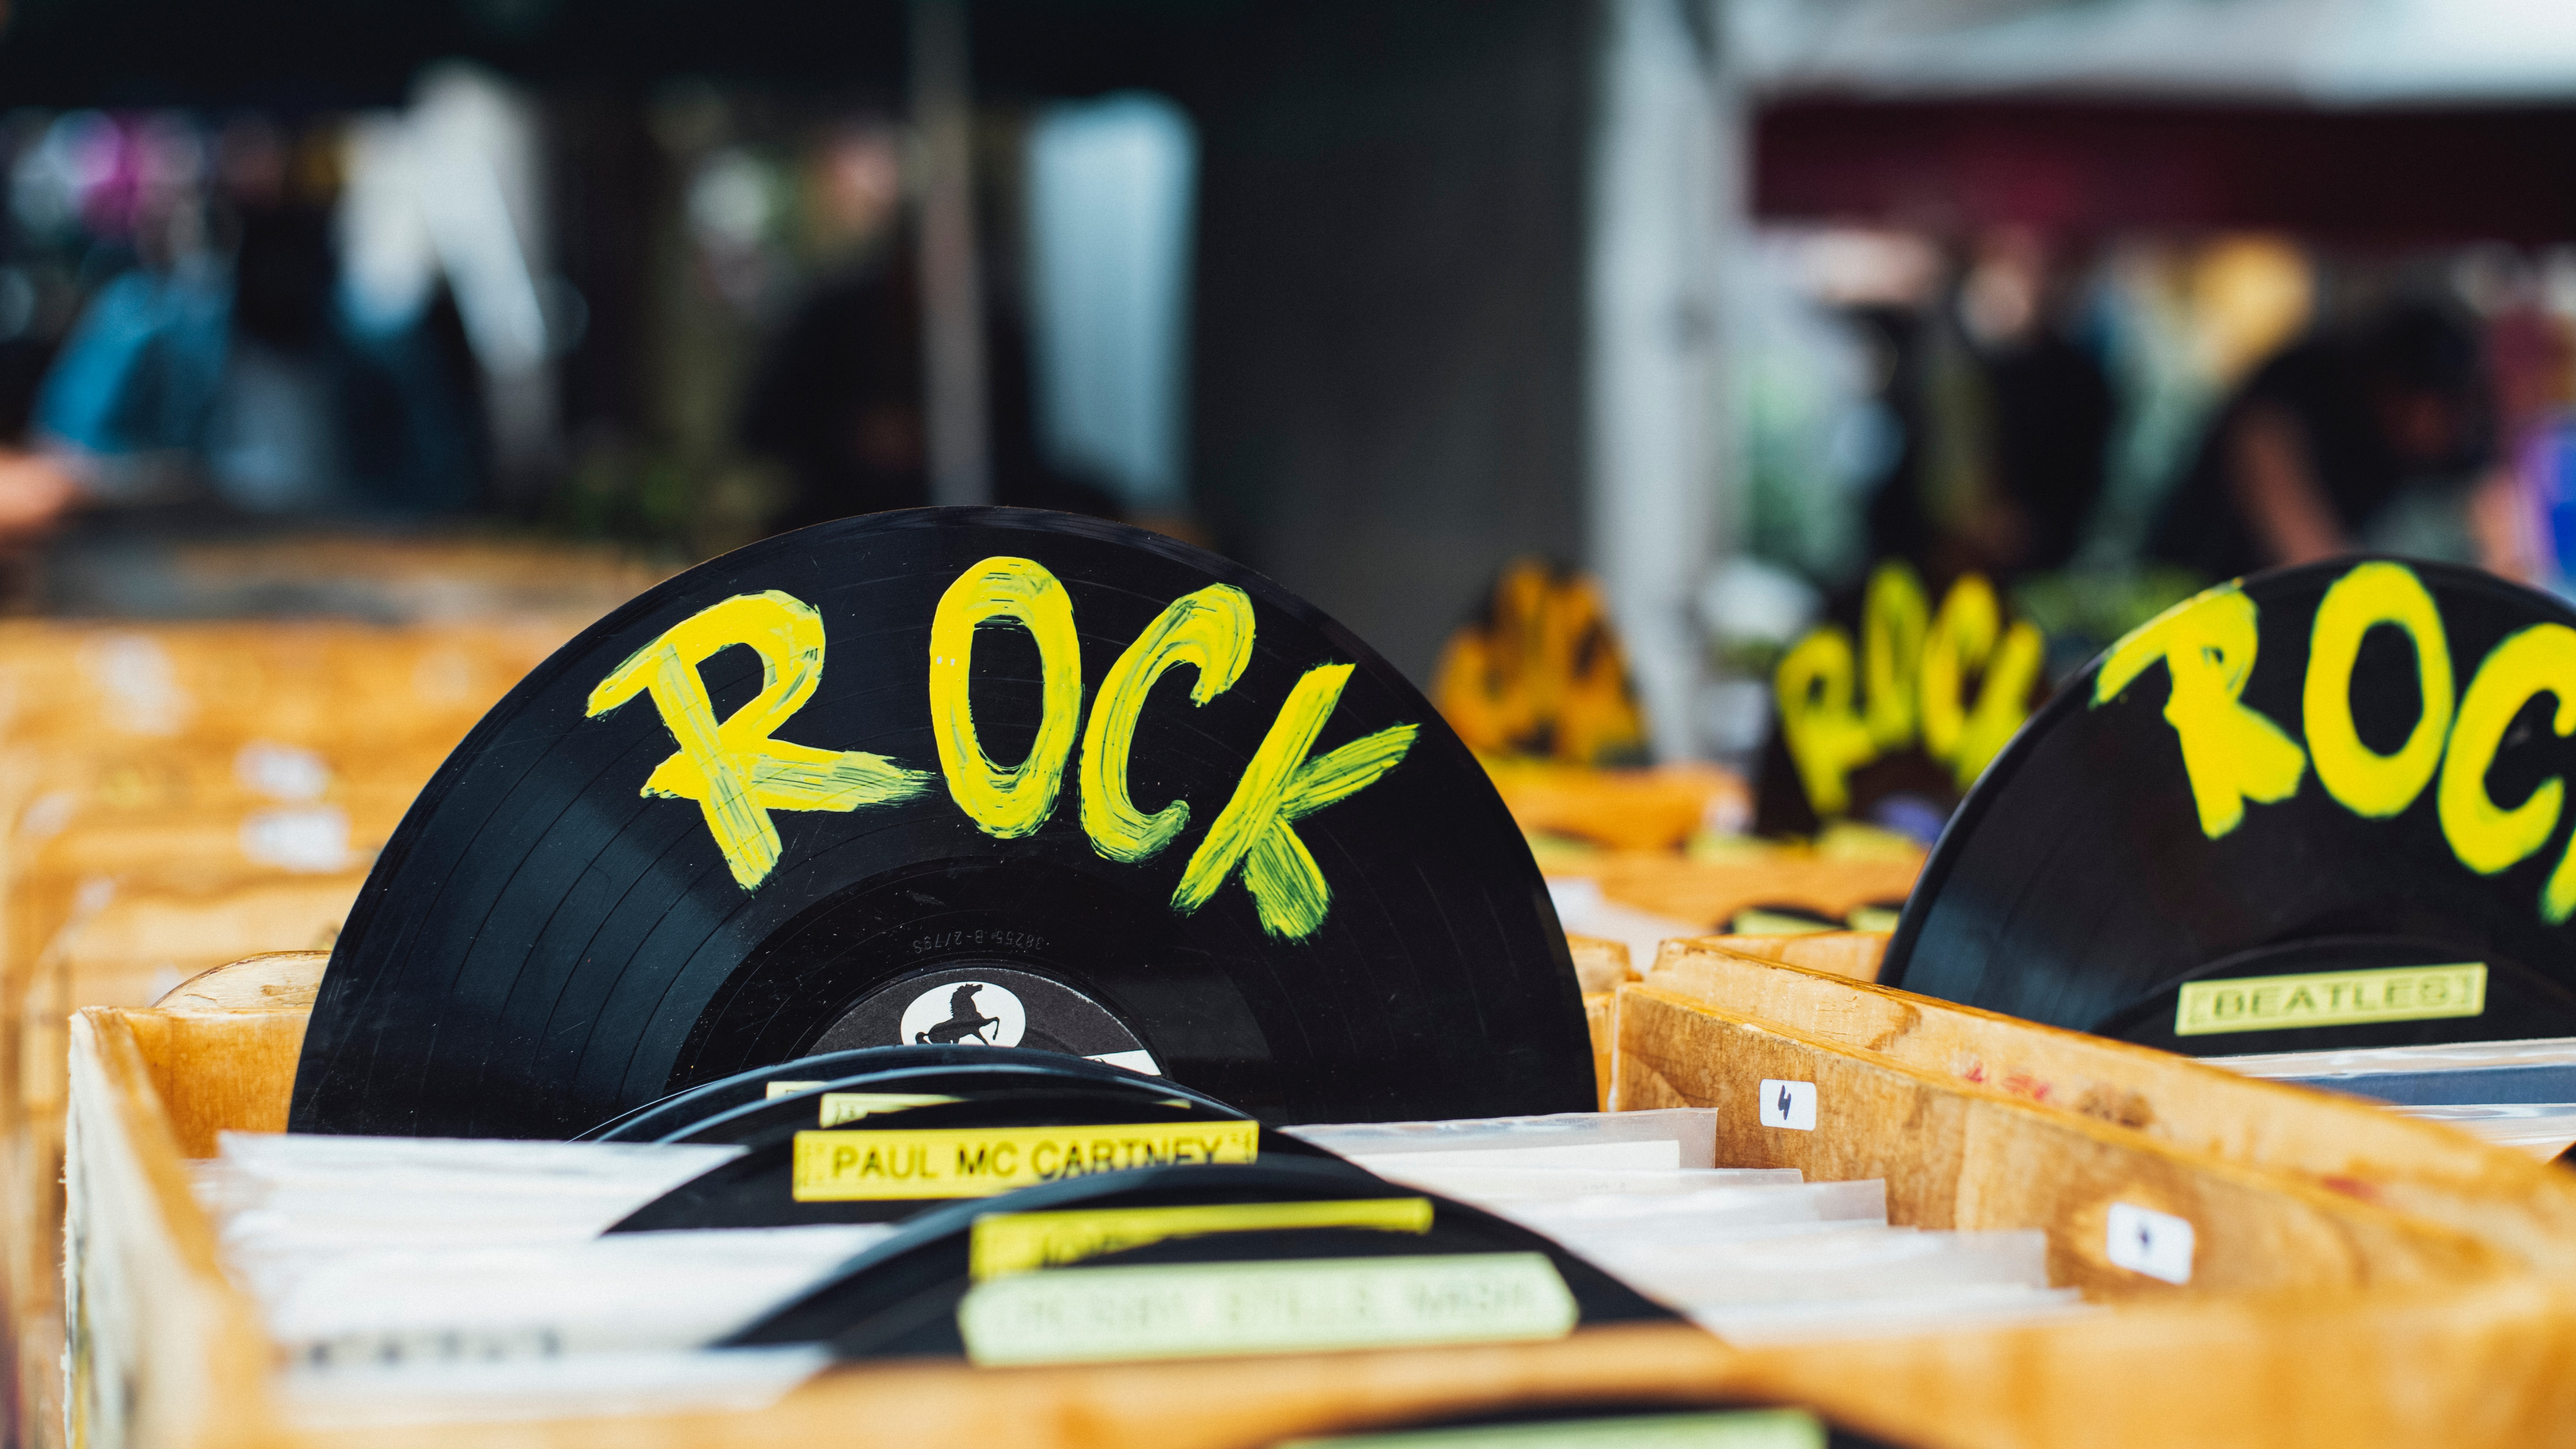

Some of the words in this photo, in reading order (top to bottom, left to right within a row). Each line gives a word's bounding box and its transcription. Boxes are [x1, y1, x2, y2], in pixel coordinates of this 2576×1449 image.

[586, 556, 1420, 944] ROCK
[2088, 561, 2576, 927] ROC
[2214, 974, 2450, 1019] BEATLES
[1777, 1084, 1792, 1121] 4
[833, 1144, 938, 1179] PAUL
[956, 1140, 1018, 1177] MC
[1030, 1136, 1222, 1181] CARTNEY
